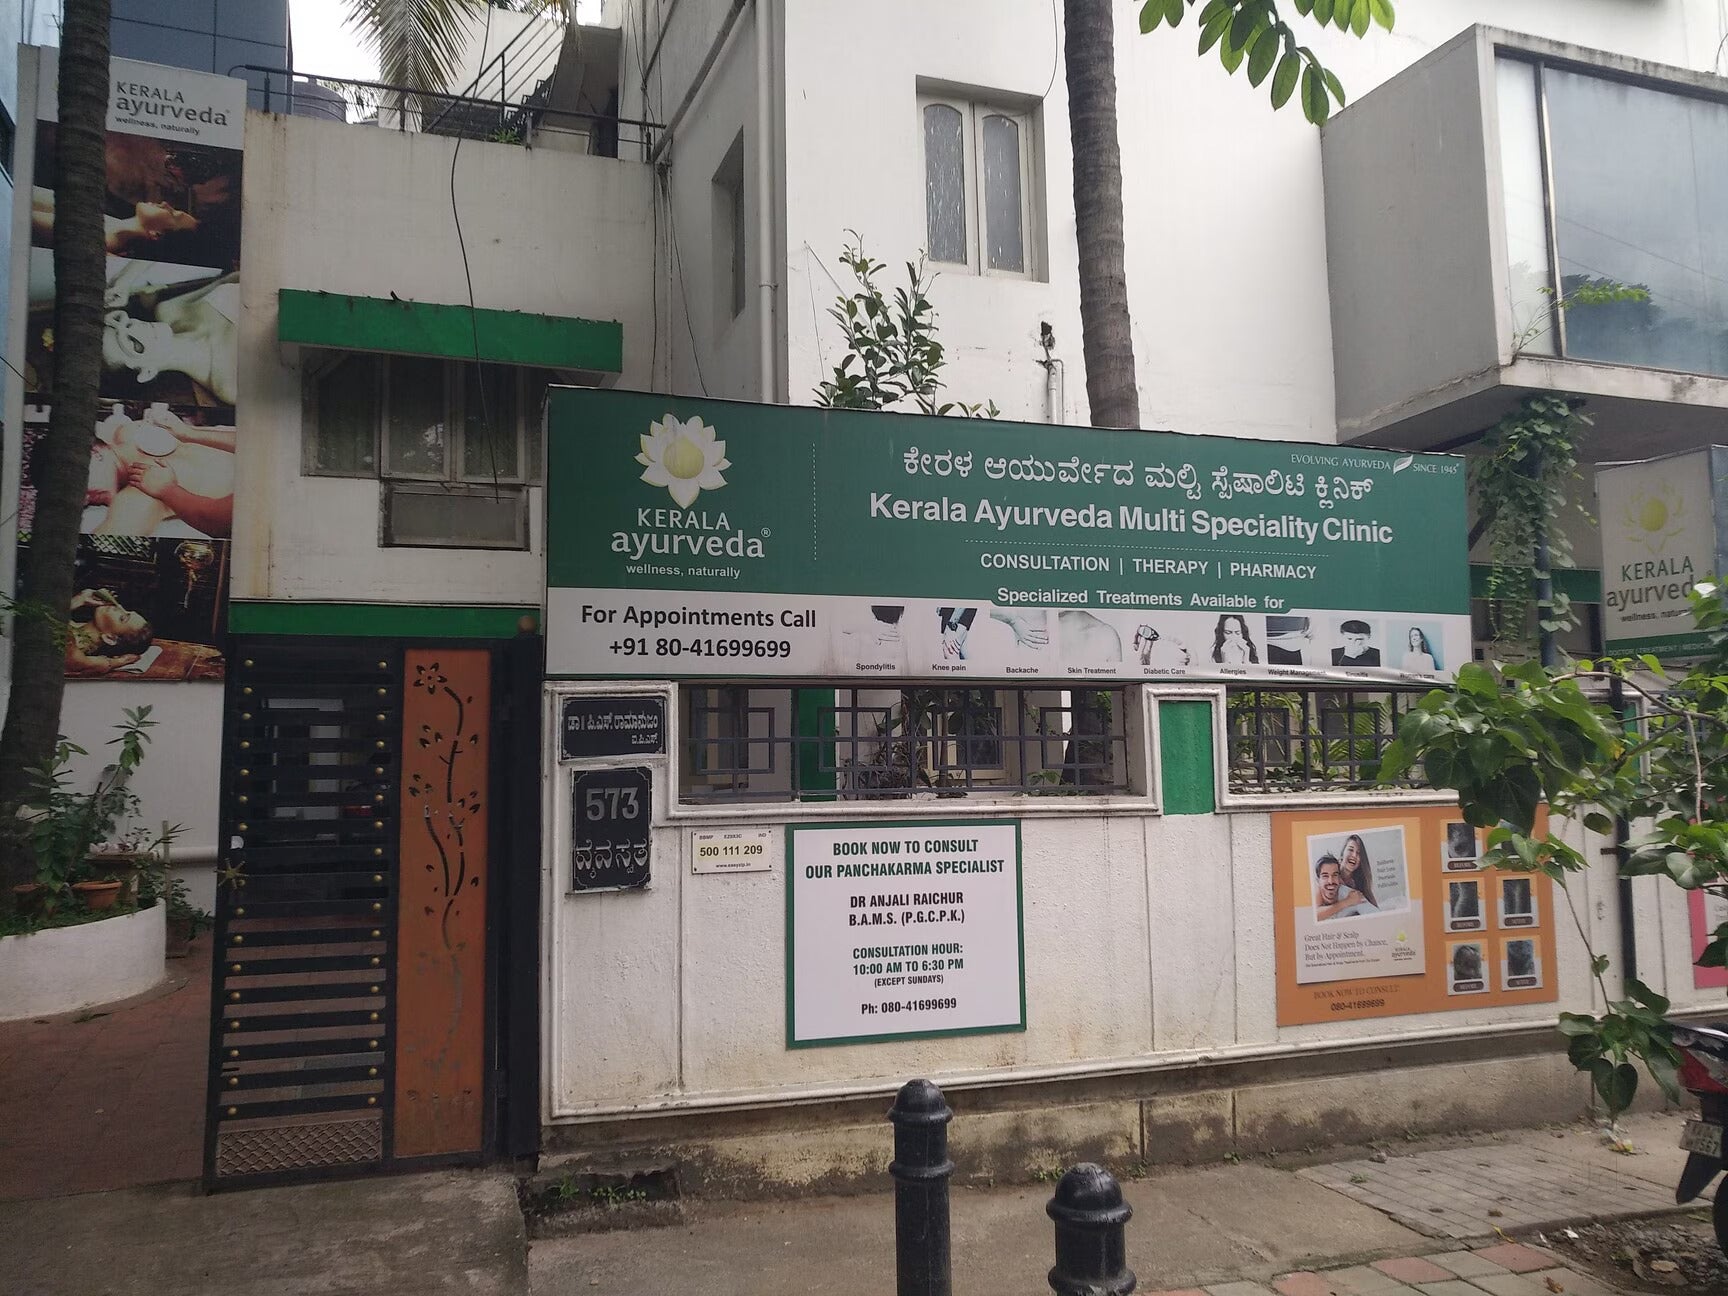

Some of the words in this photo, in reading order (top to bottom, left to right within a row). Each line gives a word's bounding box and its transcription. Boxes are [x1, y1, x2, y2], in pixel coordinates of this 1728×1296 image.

[116, 81, 185, 103] KERALA
[160, 123, 200, 136] naturally
[1291, 454, 1338, 466] EVOLVING
[1342, 458, 1391, 470] AYURVEDA
[1413, 463, 1437, 473] SINCE
[903, 446, 973, 478] ಕೇರಳ
[984, 454, 1134, 486] ಆಯುರ್ವೇದ
[1144, 462, 1202, 500] ಮಲ್ಟಿ
[1315, 475, 1374, 509] ಕ್ಲಿನಿಕ್
[637, 508, 731, 531] KERALA
[870, 492, 967, 522] Kerala
[974, 498, 1113, 530] Ayurveda
[1119, 505, 1186, 533] Multi
[1191, 510, 1318, 545] Speciality
[1323, 518, 1393, 544] Clinic
[626, 564, 684, 577] wellness,
[688, 566, 741, 580] naturally
[980, 553, 1110, 572] CONSULTATION
[1133, 558, 1209, 576] THERAPY
[1230, 563, 1317, 579] PHARMACY
[1622, 556, 1693, 581] KERALA
[997, 588, 1088, 605] Specialized
[1097, 590, 1182, 607] Treatments
[1190, 593, 1257, 609] Available
[1264, 595, 1284, 609] for
[1606, 575, 1703, 612] ayurved
[581, 605, 616, 624] For
[623, 605, 774, 628] Appointments
[780, 609, 816, 628] Call
[609, 638, 649, 656] +91
[655, 638, 791, 658] 80-41699699
[855, 663, 896, 672] Spondylitis
[951, 664, 966, 672] pain
[1006, 666, 1039, 674] Backache
[1083, 667, 1116, 675] Treatment
[1219, 668, 1247, 676] Allergies
[586, 787, 640, 821] 573
[700, 846, 719, 857] 500
[723, 845, 739, 856] 111
[743, 844, 763, 855] 209
[833, 842, 868, 856] BOOK
[871, 841, 901, 855] NOW
[904, 840, 921, 854] TO
[924, 839, 979, 853] CONSULT
[805, 865, 832, 879] OUR
[837, 862, 932, 878] PANCHAKARMA
[935, 859, 1005, 874] SPECIALIST
[850, 895, 866, 908] DR
[869, 893, 910, 908] ANJALI
[913, 891, 964, 906] RAICHUR
[849, 912, 897, 927] B.A.M.S.
[901, 909, 965, 927] (P.G.C.P.K.)
[853, 945, 928, 960] CONSULTATION
[931, 943, 963, 956] HOUR:
[1333, 941, 1356, 950] Happen
[853, 963, 883, 976] 10:00
[885, 962, 902, 974] AM
[905, 961, 919, 973] TO
[921, 959, 945, 972] 6:30
[948, 958, 964, 970] PM
[874, 977, 905, 989] (EXCEPT
[907, 975, 944, 987] SUNDAYS)
[861, 1003, 878, 1015] Ph:
[881, 998, 957, 1013] 080-41699699
